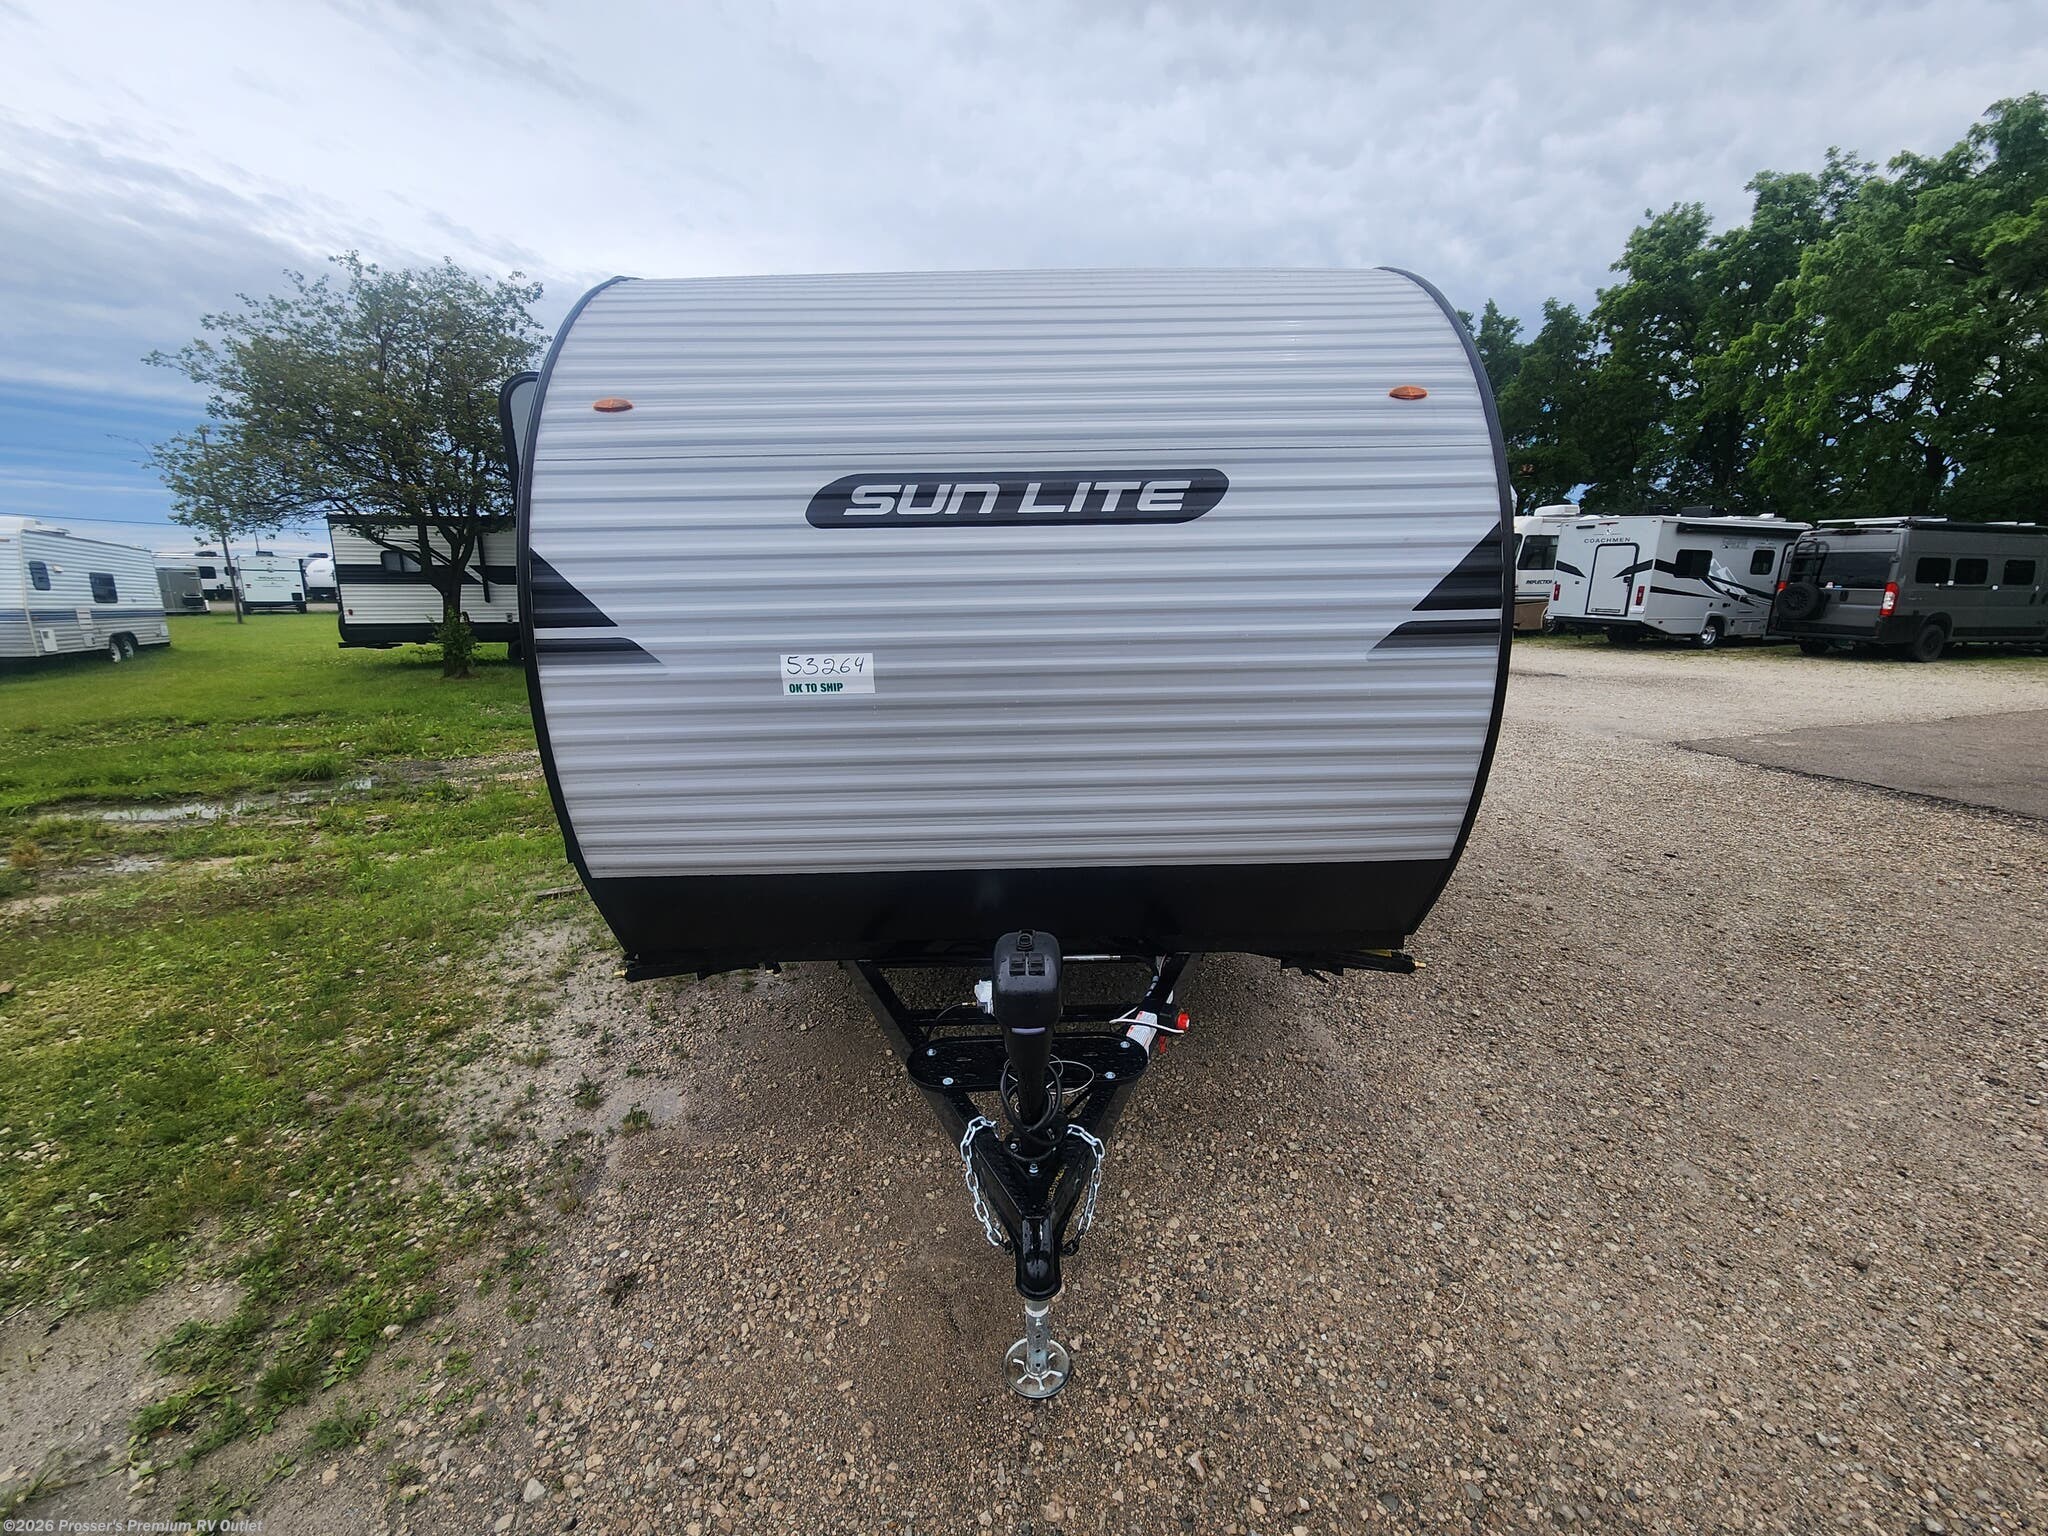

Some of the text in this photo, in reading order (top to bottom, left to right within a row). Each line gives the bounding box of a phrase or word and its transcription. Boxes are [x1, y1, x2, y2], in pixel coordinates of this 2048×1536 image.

[1017, 480, 1193, 514] LITE
[787, 656, 865, 675] 53264
[789, 682, 844, 693] OK TO SHIP
